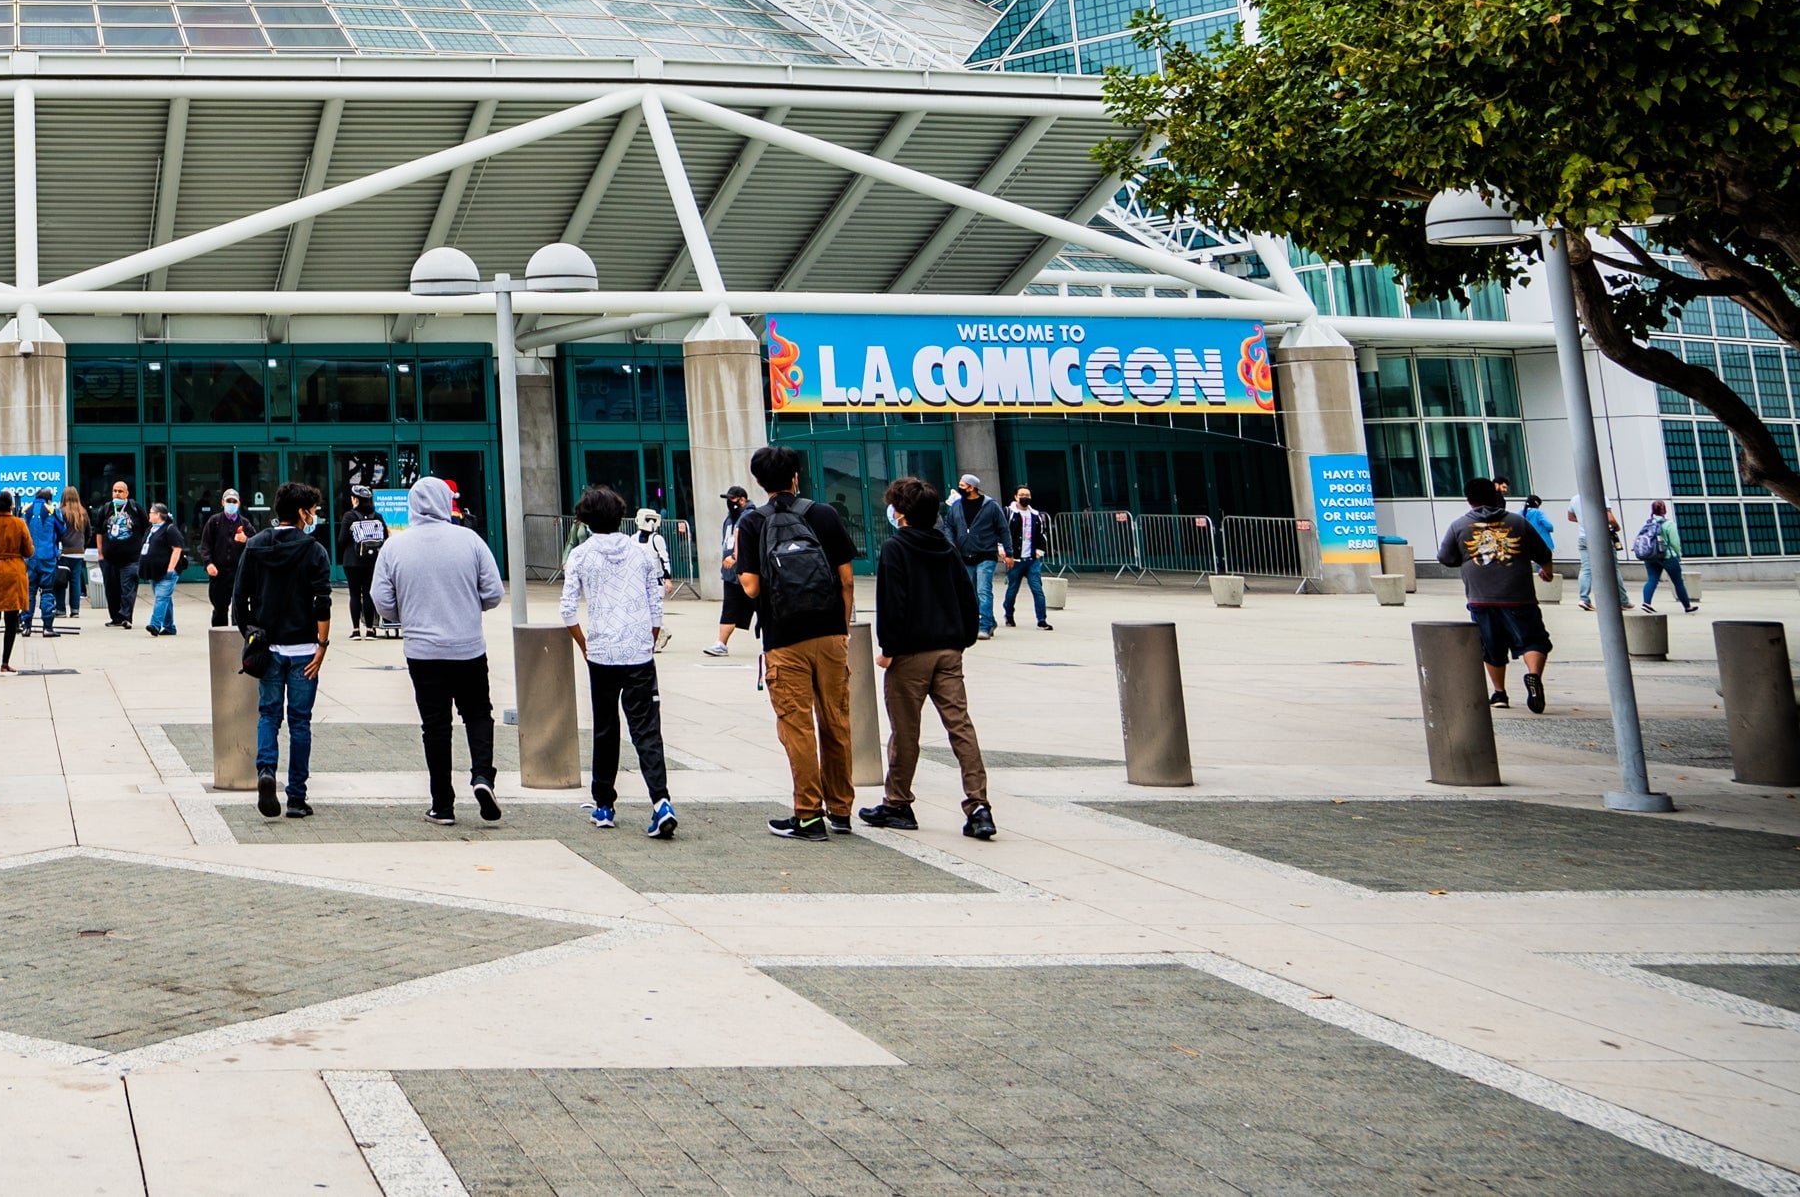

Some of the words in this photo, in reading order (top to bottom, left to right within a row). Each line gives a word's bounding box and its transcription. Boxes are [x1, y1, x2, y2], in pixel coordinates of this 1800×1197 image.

[957, 323, 1055, 342] WELCOME
[1059, 324, 1086, 342] TO
[1085, 346, 1226, 406] CON
[0, 471, 28, 482] HAVE
[31, 471, 61, 482] YOUR
[1323, 470, 1355, 480] HAVE
[1329, 483, 1366, 493] PROOF
[1323, 511, 1342, 522] OR
[1334, 525, 1366, 536] CV-19
